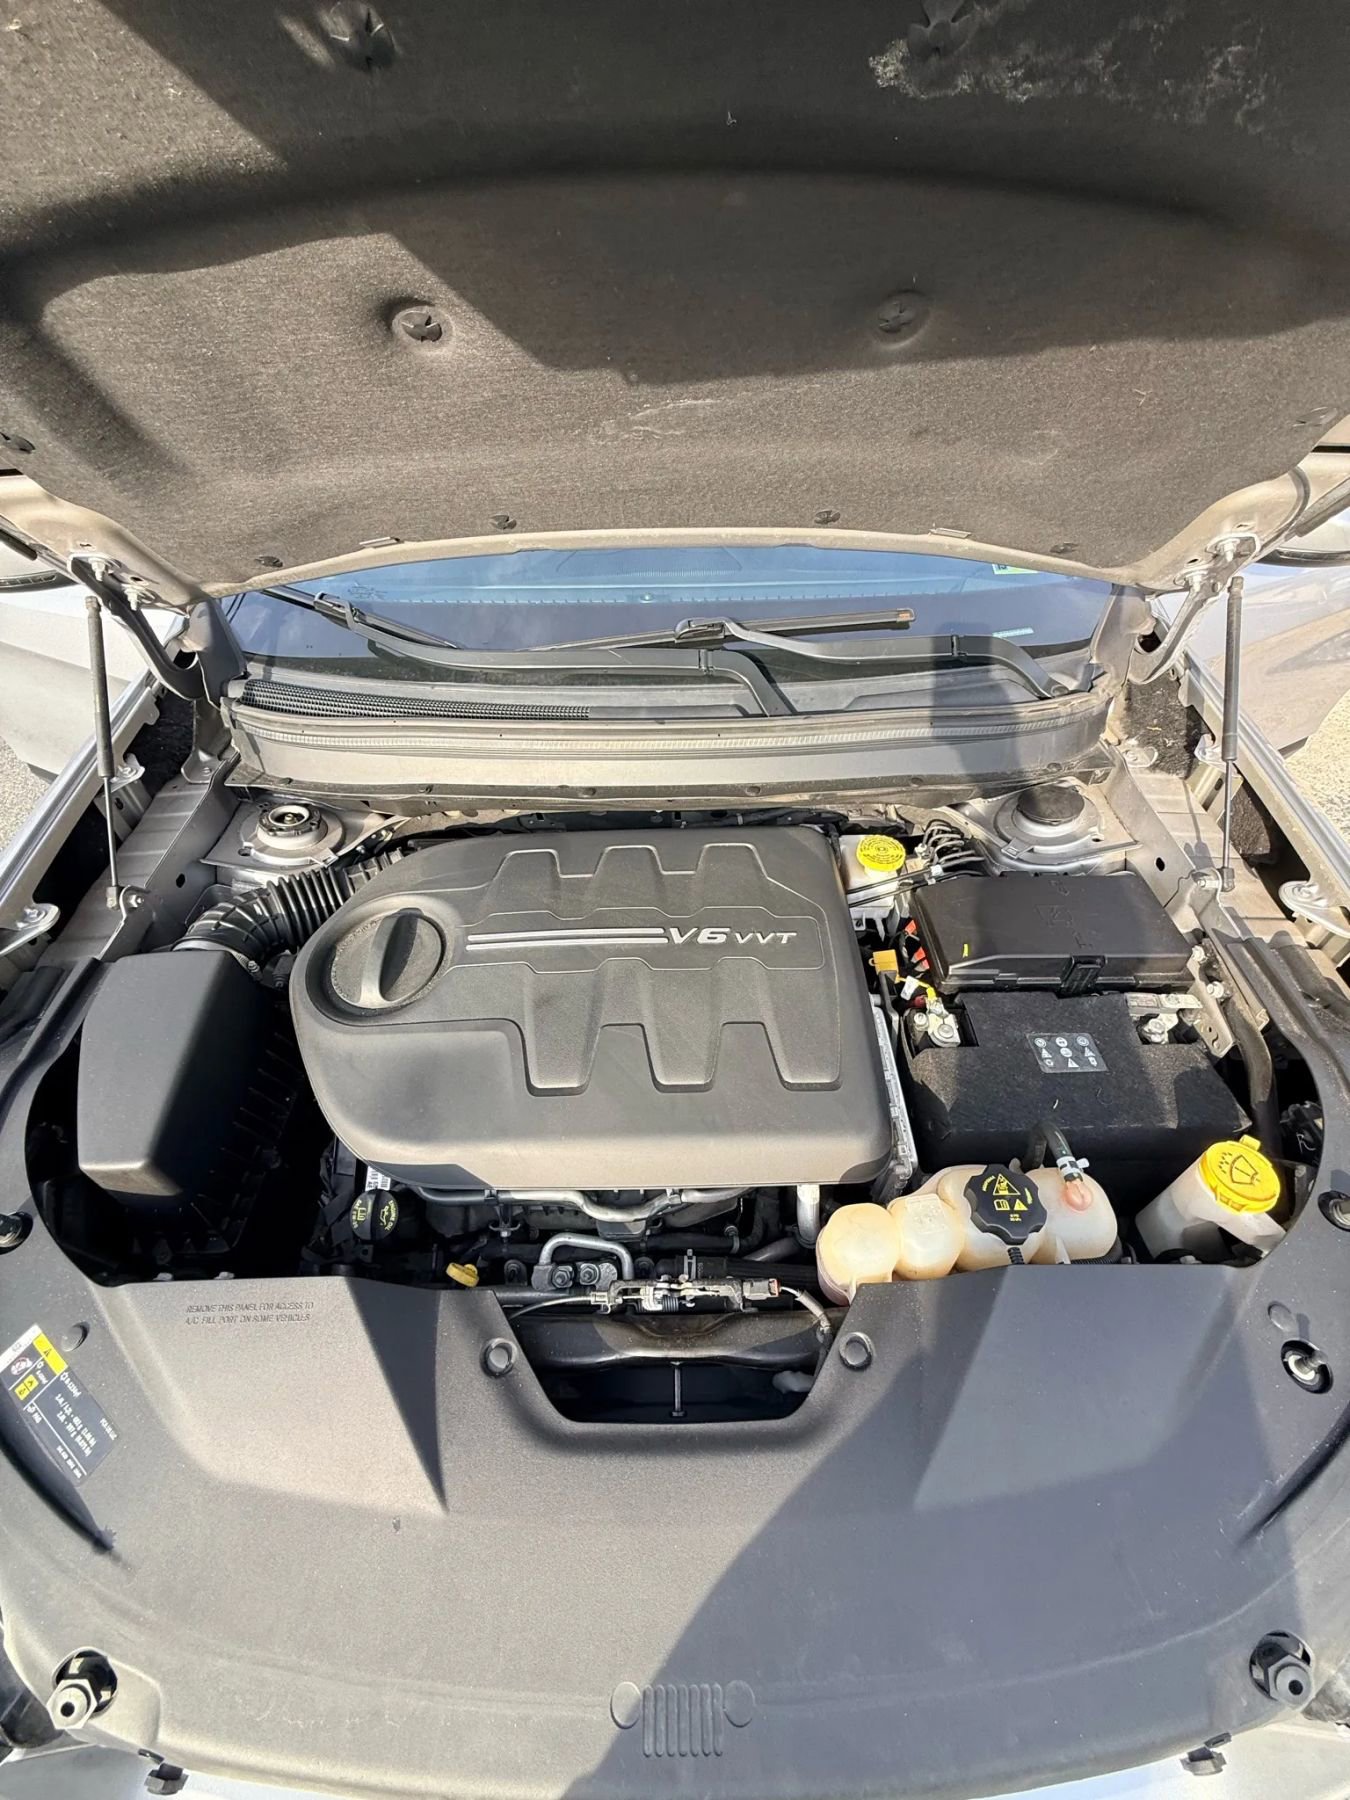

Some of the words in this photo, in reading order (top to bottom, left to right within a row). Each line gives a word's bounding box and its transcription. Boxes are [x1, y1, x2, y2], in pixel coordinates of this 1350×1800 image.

[669, 927, 731, 944] V6
[735, 932, 798, 944] VVT
[388, 1200, 396, 1222] ENGINE
[385, 1222, 394, 1230] OIL
[186, 1305, 217, 1313] REMOVE
[218, 1304, 234, 1312] THIS
[234, 1303, 258, 1311] PANEL
[259, 1302, 274, 1311] FOR
[276, 1302, 303, 1310] ACCESS
[304, 1302, 314, 1310] TO
[201, 1316, 216, 1324] FILL
[219, 1316, 238, 1324] PORT
[239, 1315, 250, 1323] ON
[253, 1314, 274, 1322] SOME
[275, 1314, 310, 1322] VEHICLES
